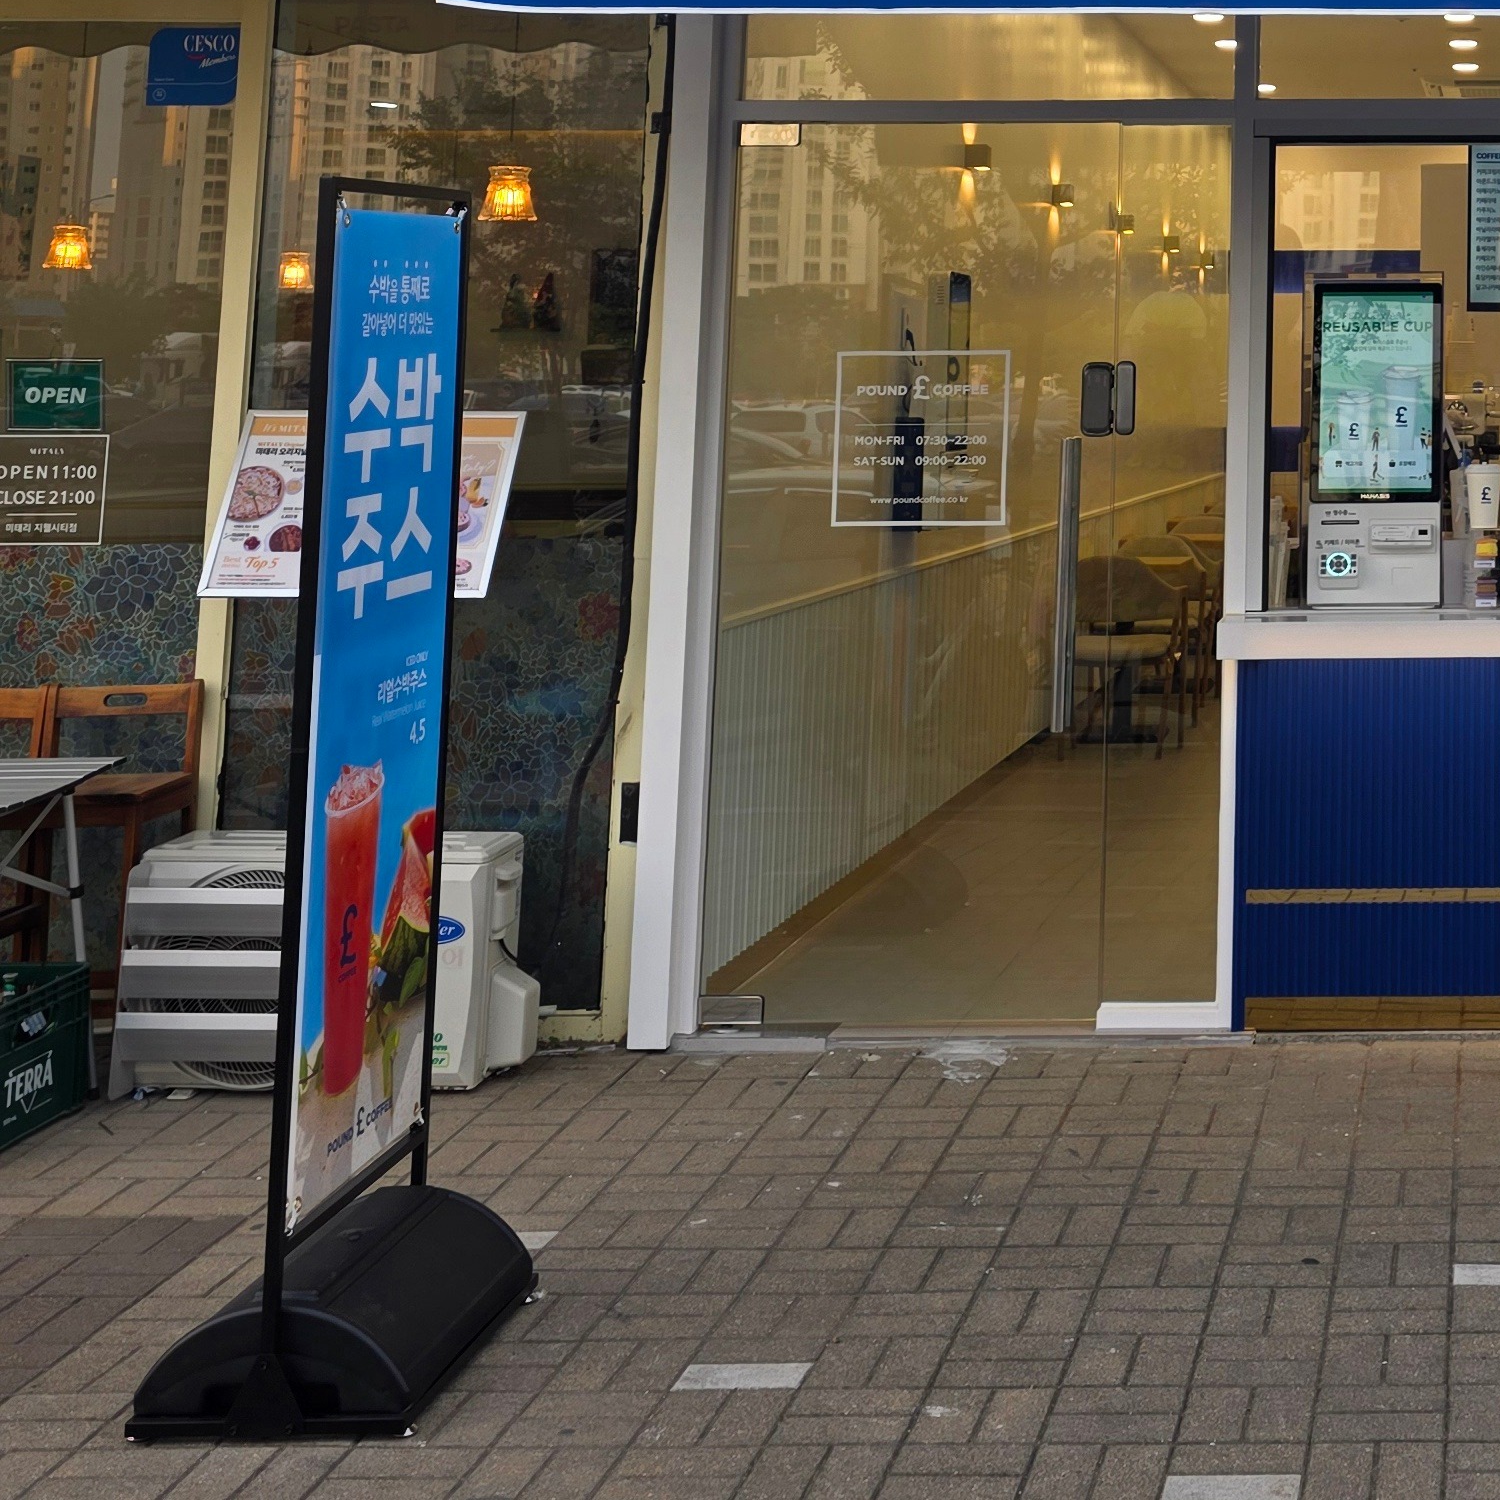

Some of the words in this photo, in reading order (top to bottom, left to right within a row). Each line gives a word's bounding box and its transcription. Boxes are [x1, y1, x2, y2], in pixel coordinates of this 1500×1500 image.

[183, 34, 235, 52] CESCO
[369, 275, 398, 304] 수박을
[399, 312, 407, 335] 더
[408, 312, 434, 335] 맛있는
[1323, 321, 1399, 332] REUSABLE
[1403, 321, 1434, 332] CUP
[25, 386, 86, 404] OPEN
[857, 385, 907, 396] POUND
[933, 384, 989, 395] COFFEE
[344, 353, 441, 483] 수박
[855, 436, 904, 446] MON-FRI
[915, 435, 987, 446] 07:30~22:00
[854, 456, 904, 466] SAT-SUN
[915, 455, 986, 466] 09:00~22:00
[52, 465, 97, 480] 11:00
[49, 490, 96, 505] 21:00
[337, 486, 433, 619] 주스
[377, 667, 428, 705] 리얼수박주스
[4, 1058, 54, 1108] TERRA
[327, 1127, 353, 1157] POUND
